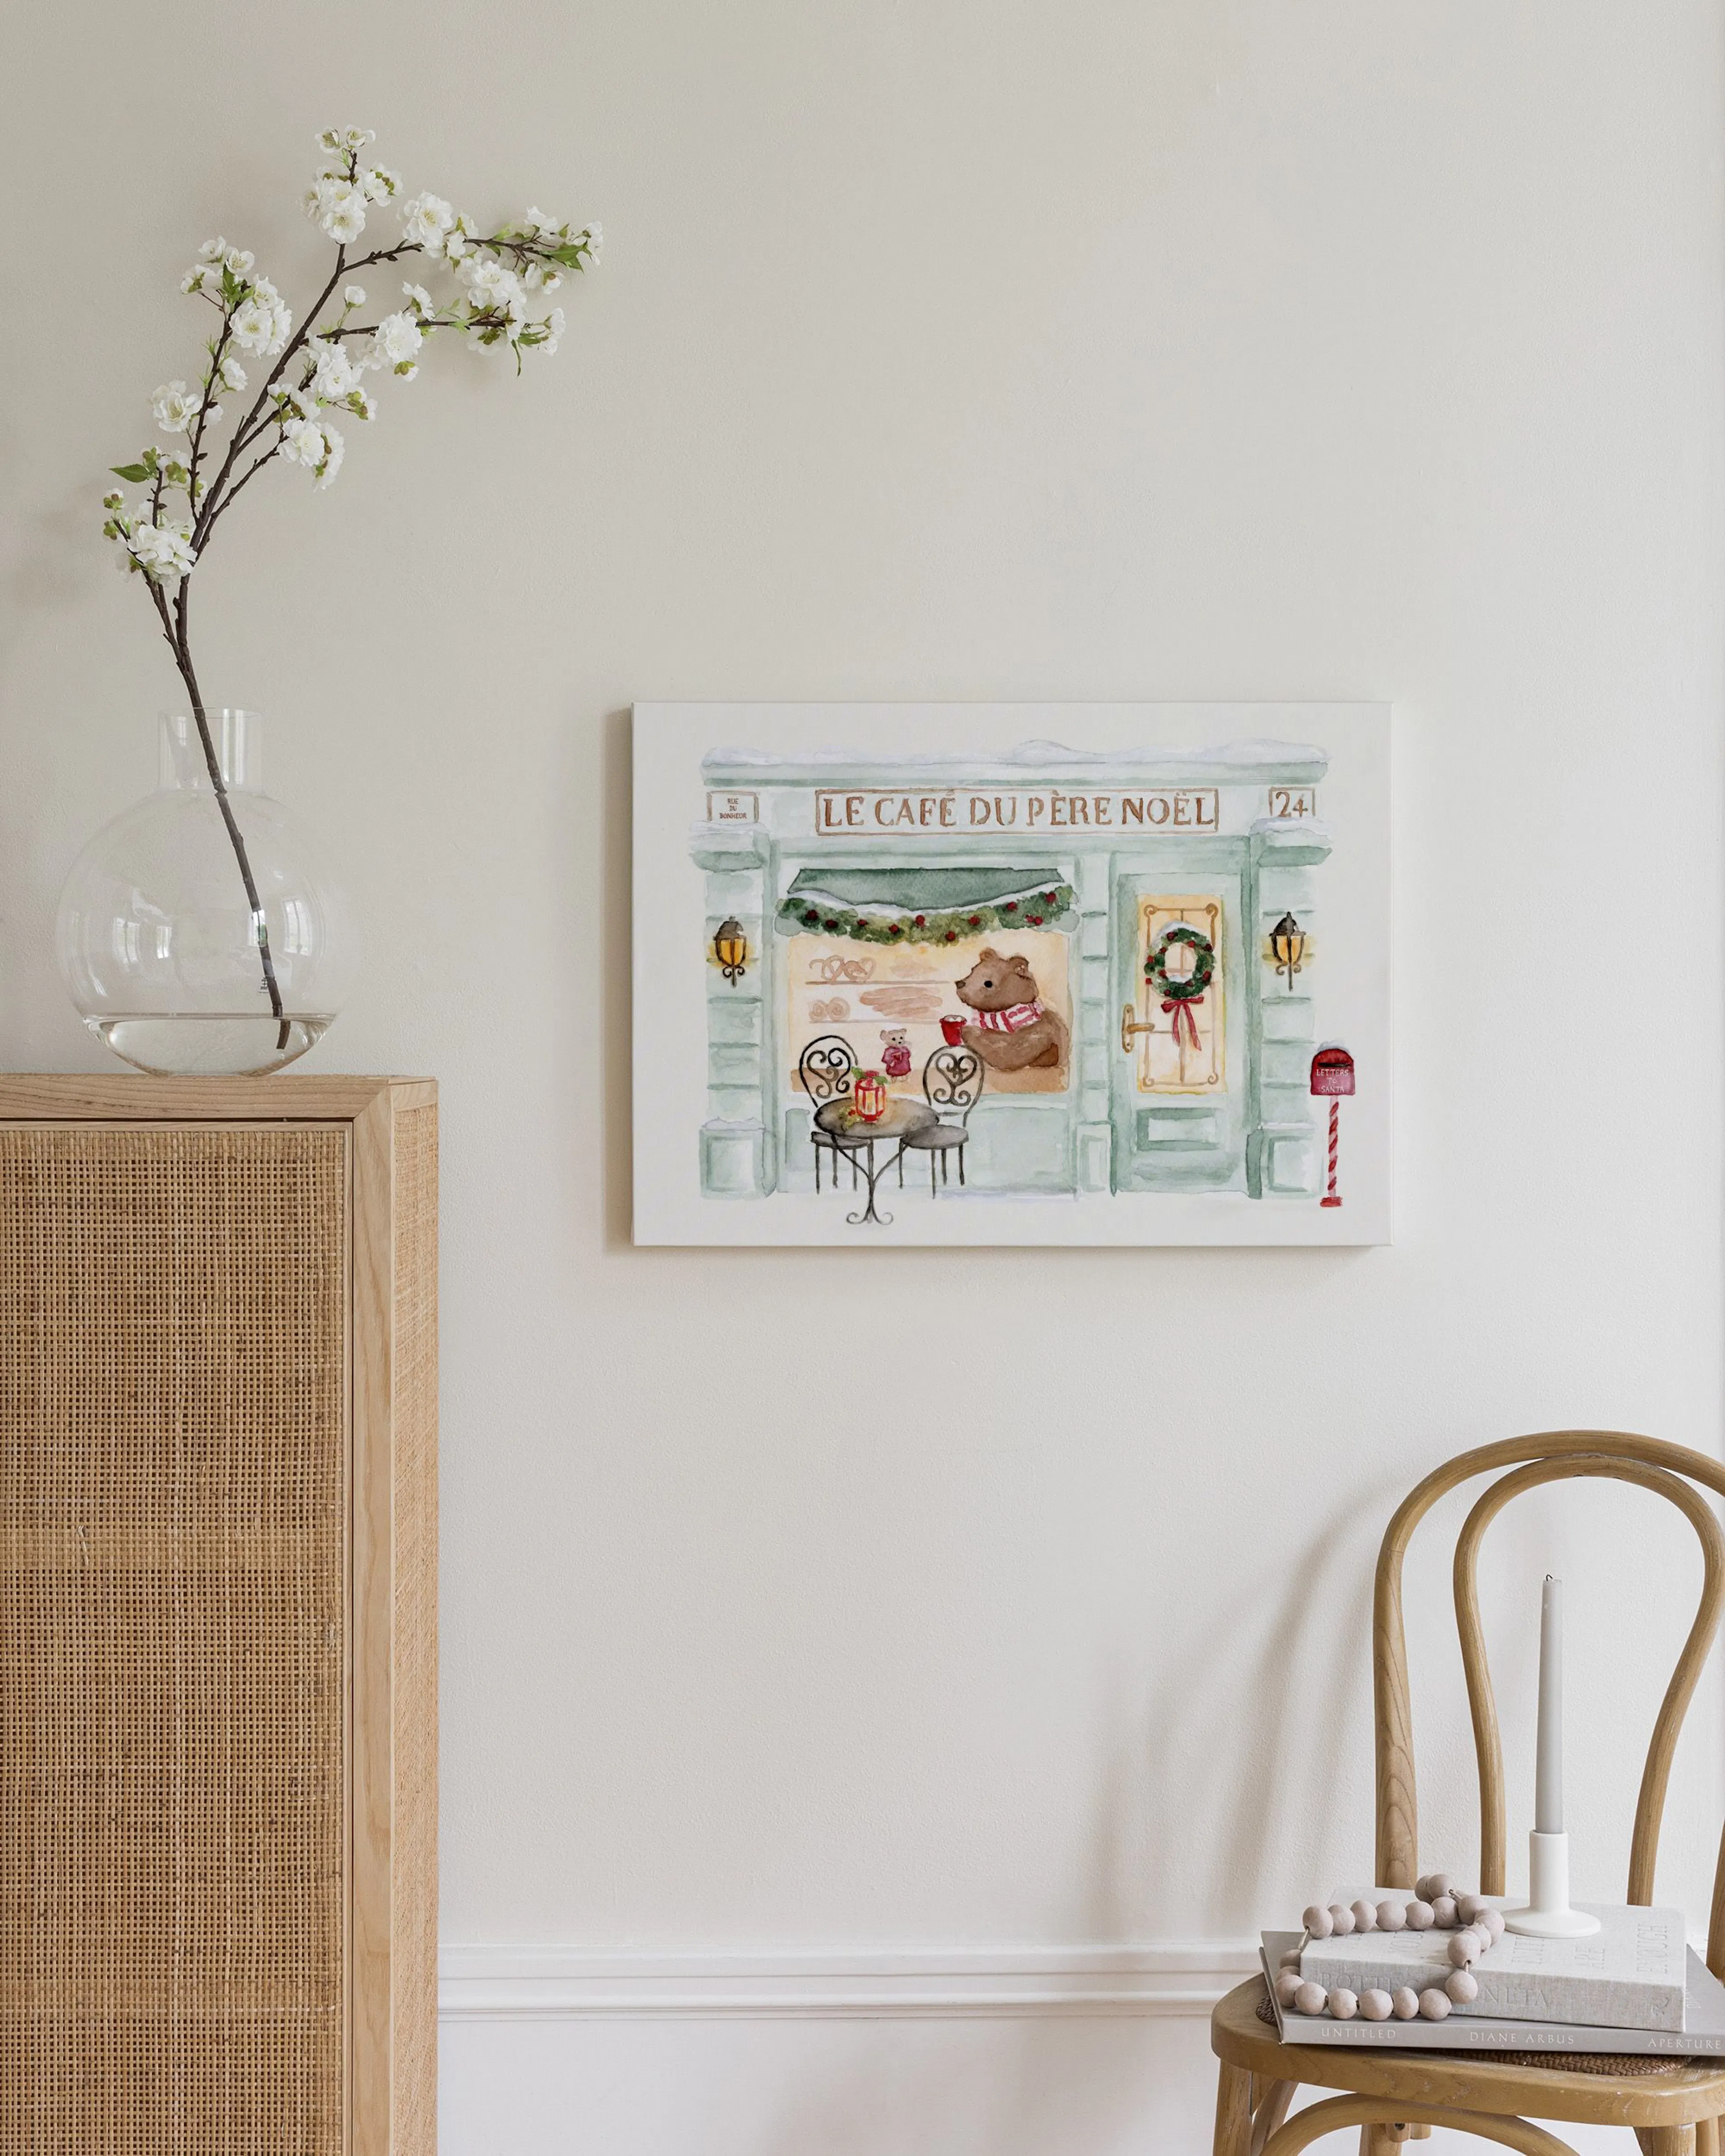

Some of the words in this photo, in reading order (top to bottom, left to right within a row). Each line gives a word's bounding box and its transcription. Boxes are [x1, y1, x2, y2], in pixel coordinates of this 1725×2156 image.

[823, 796, 866, 826] LE
[875, 791, 957, 827] CAFÉ
[969, 796, 1017, 826] DU
[1026, 790, 1113, 826] PÈRE
[1121, 792, 1215, 826] NOËL
[1275, 791, 1309, 817] 24
[1322, 2028, 1396, 2039] UNTITLED
[1470, 2032, 1517, 2043] DIANE
[1525, 2034, 1574, 2044] ARBUS
[1647, 2037, 1721, 2050] APERTURE
